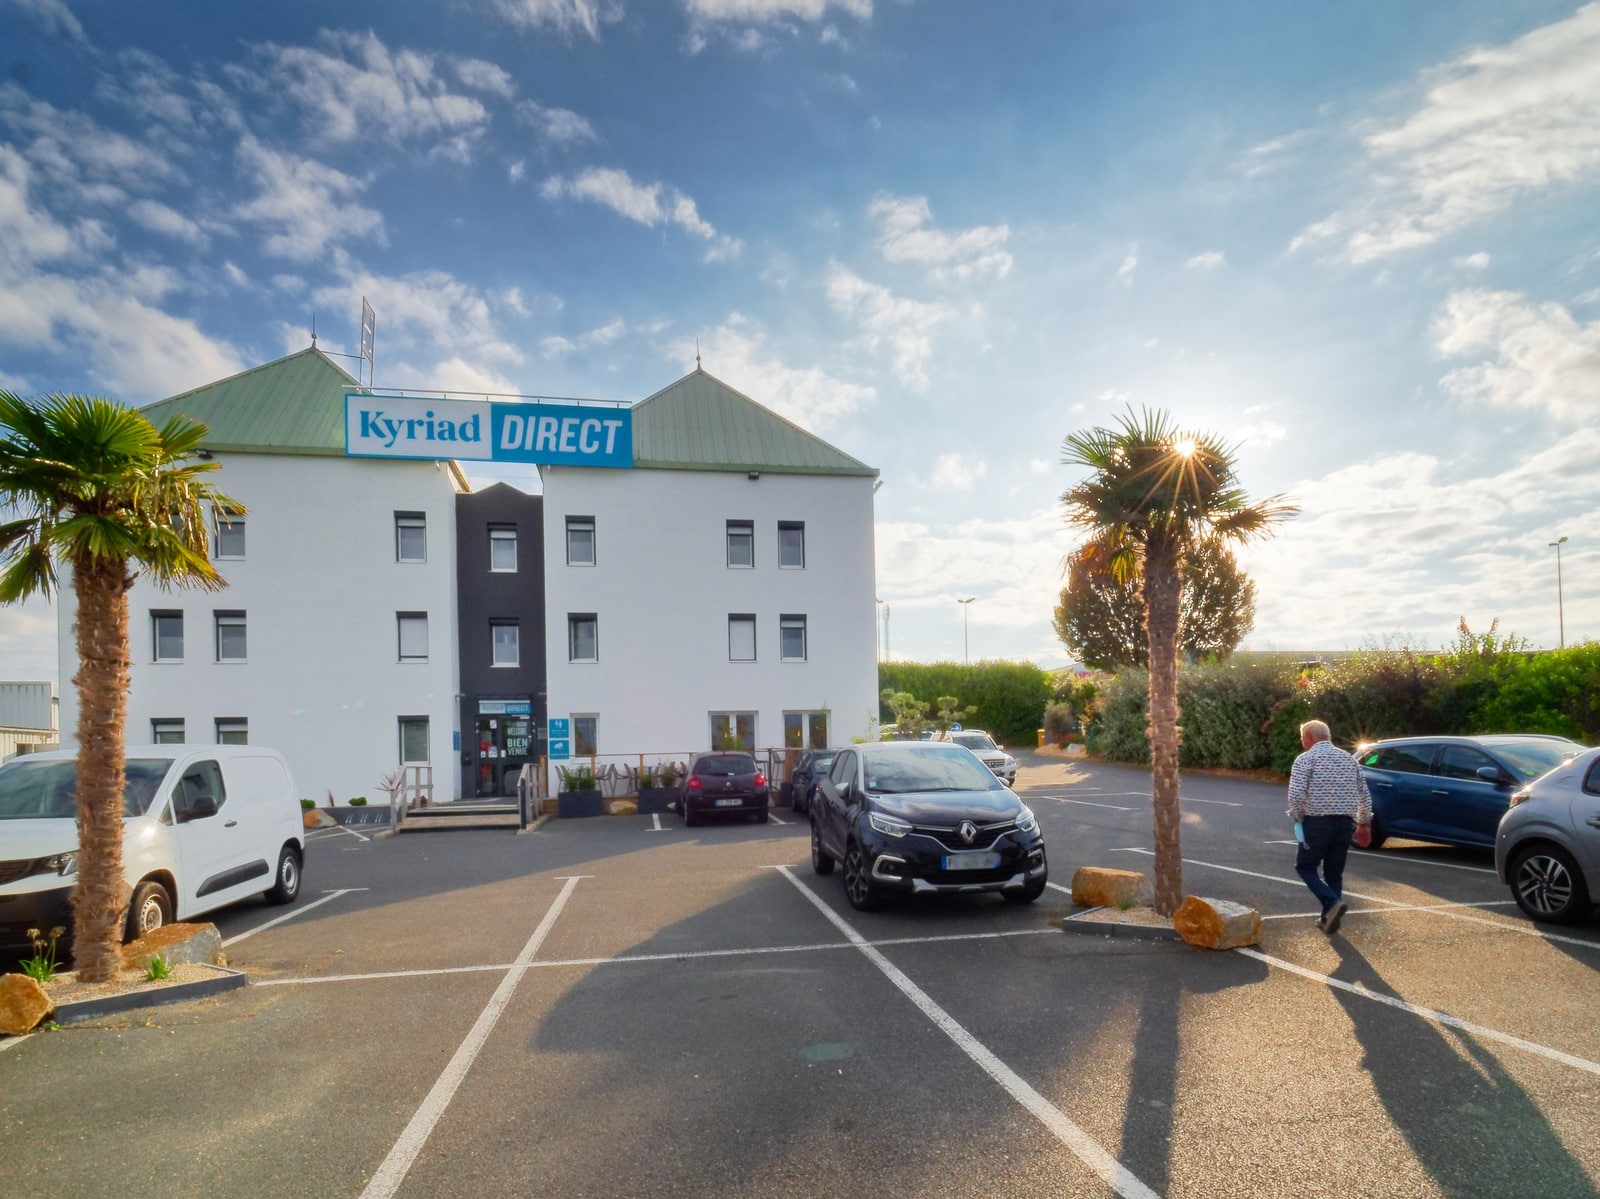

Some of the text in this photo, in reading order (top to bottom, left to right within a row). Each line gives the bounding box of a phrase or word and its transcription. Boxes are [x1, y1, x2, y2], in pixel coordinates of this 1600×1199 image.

[359, 410, 623, 455] Kyriad DIRECT
[507, 738, 528, 748] BIEN
[507, 747, 528, 756] VENUE
